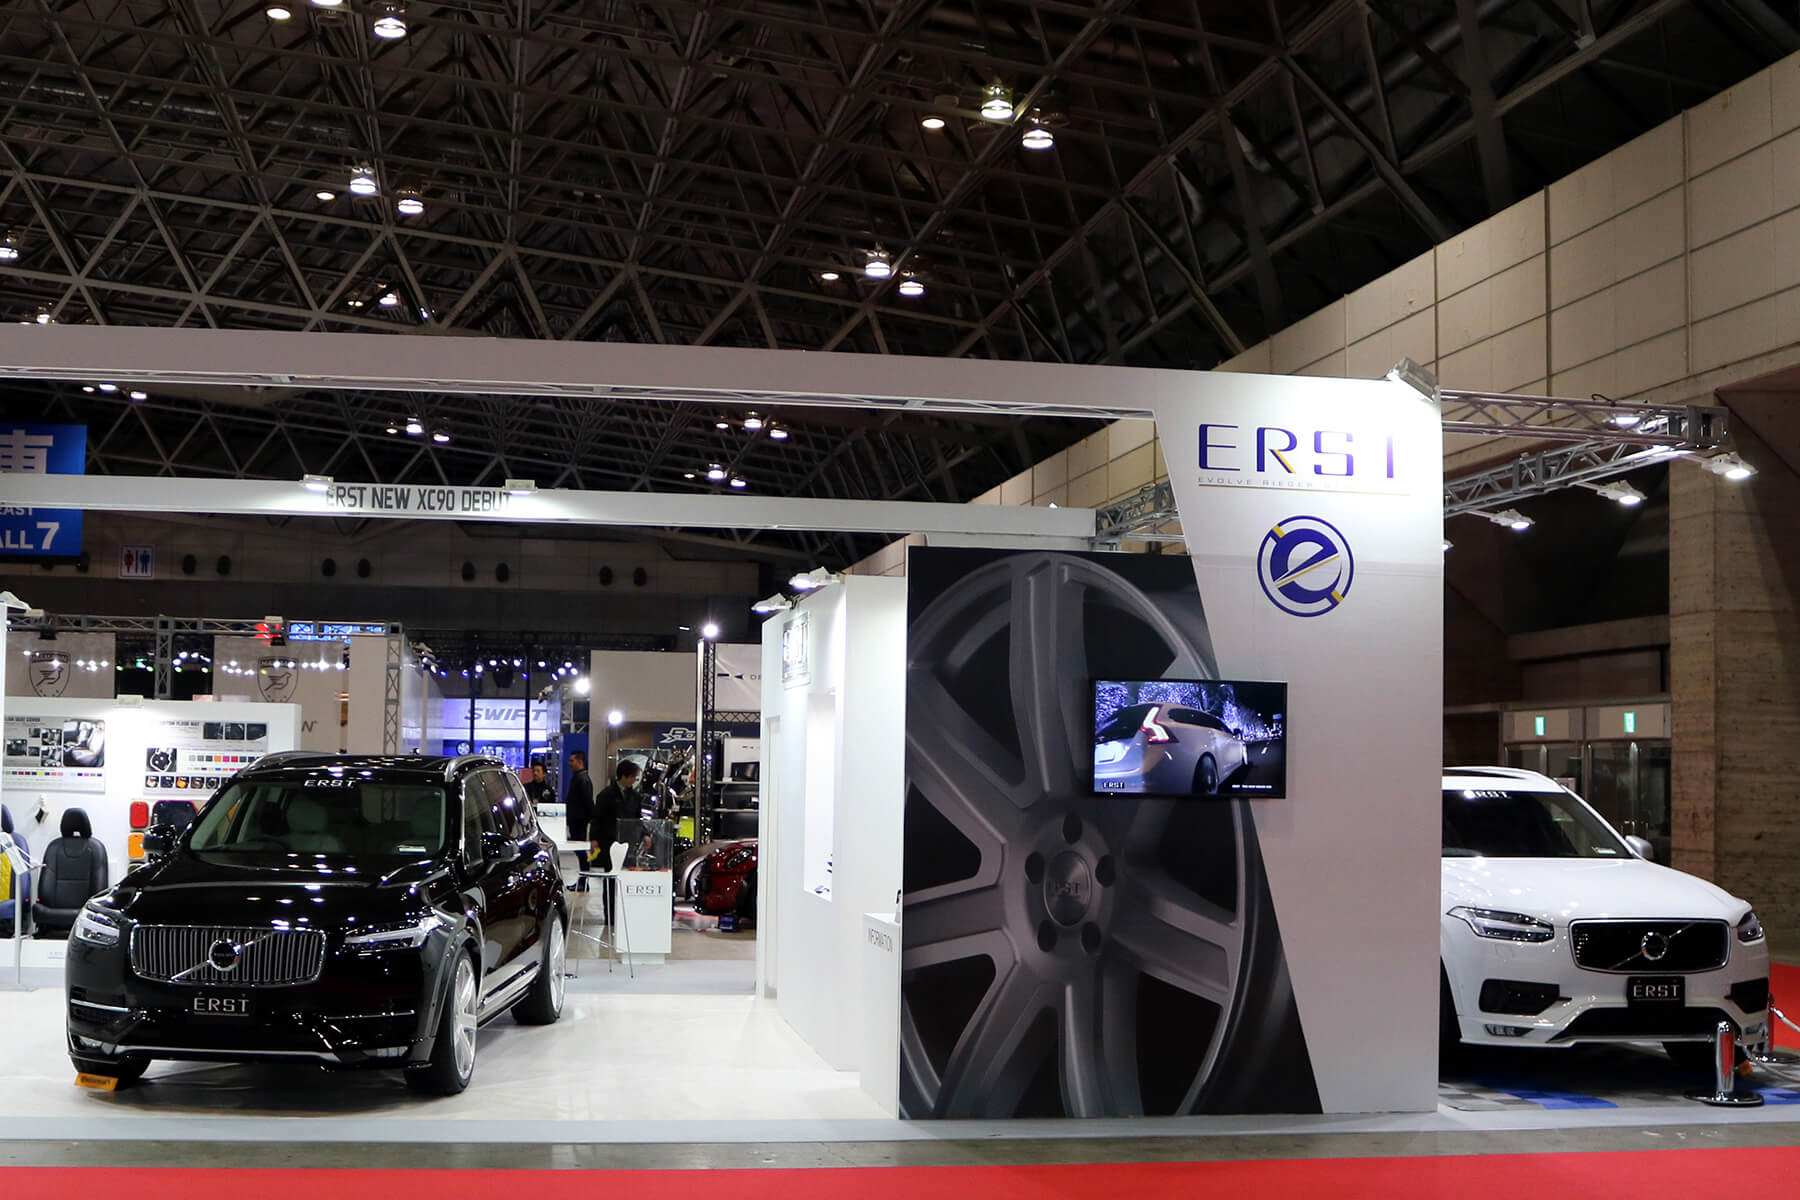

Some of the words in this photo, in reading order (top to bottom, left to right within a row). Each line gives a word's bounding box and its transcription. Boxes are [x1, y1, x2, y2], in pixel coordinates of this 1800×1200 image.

[326, 486, 367, 508] ERST
[371, 487, 411, 510] NEW
[416, 489, 455, 511] XC90
[461, 490, 511, 511] DEBUT
[36, 521, 60, 550] 7
[464, 707, 547, 721] SWIFT
[303, 779, 357, 788] ERST
[625, 884, 664, 895] ERST
[1632, 984, 1681, 998] ERST
[193, 997, 250, 1013] ERST
